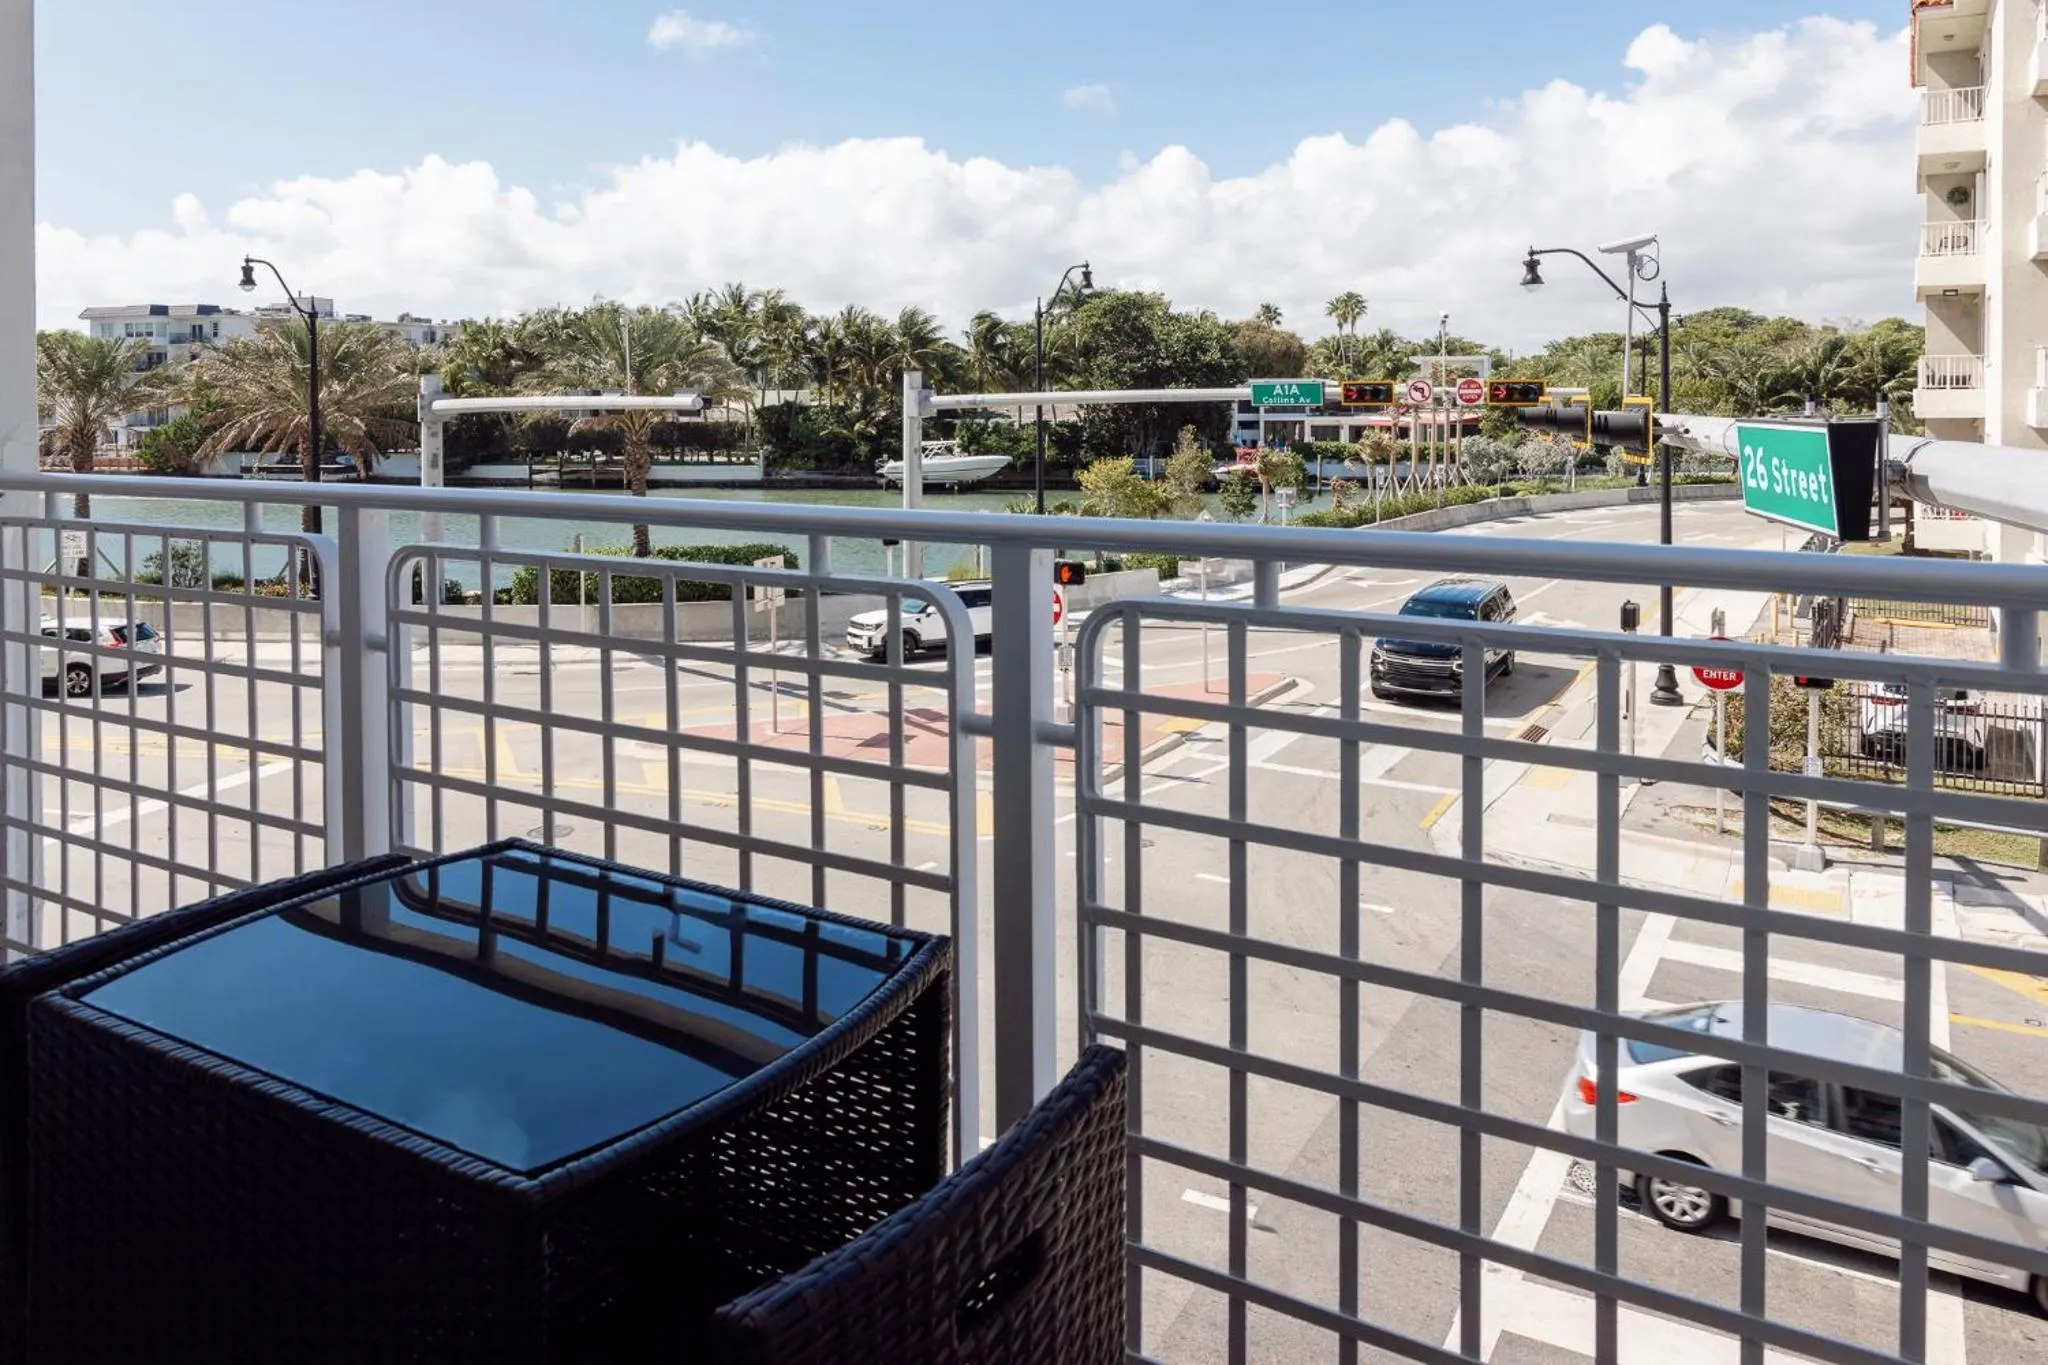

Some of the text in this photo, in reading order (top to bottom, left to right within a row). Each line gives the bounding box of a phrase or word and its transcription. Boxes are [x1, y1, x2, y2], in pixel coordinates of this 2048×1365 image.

[1273, 384, 1300, 396] A1A
[1743, 444, 1829, 505] 26 Street
[1703, 669, 1737, 681] ENTER
